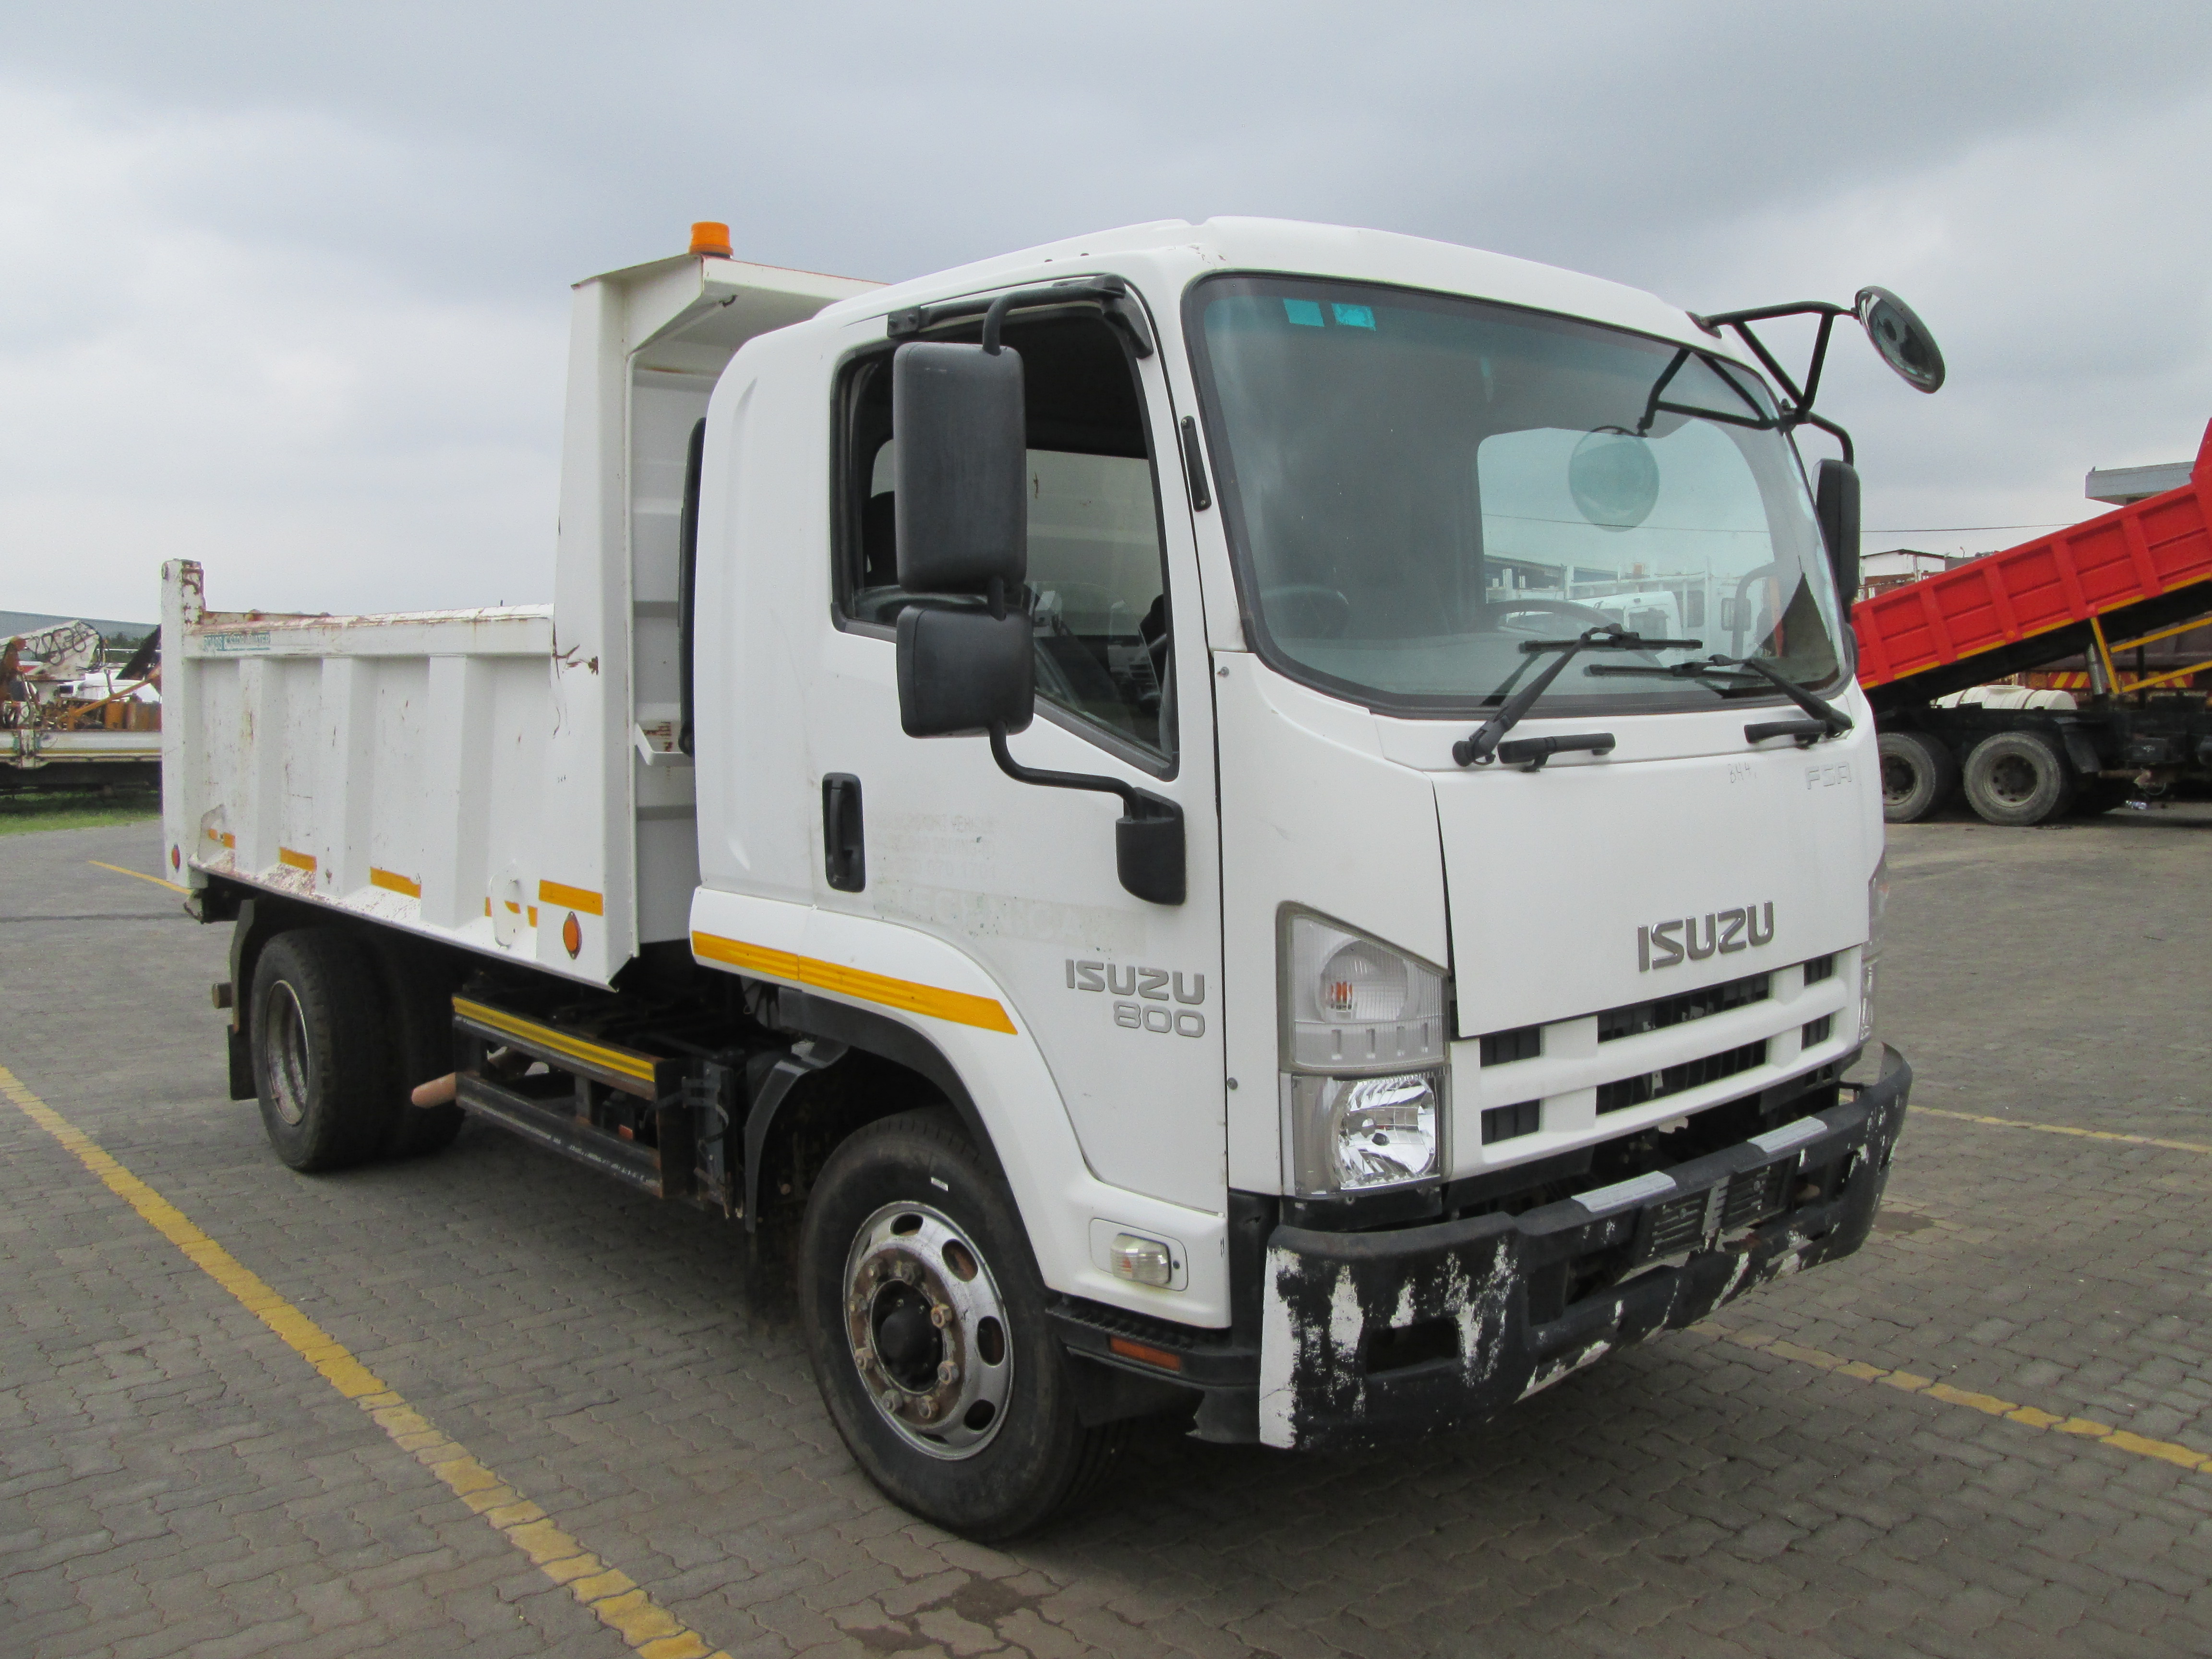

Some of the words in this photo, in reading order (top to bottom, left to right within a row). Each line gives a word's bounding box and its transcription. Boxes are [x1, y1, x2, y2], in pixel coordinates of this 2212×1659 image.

[1637, 900, 1774, 972] ISUZU
[1065, 959, 1205, 1005] ISUZU
[1113, 1000, 1205, 1038] 800
